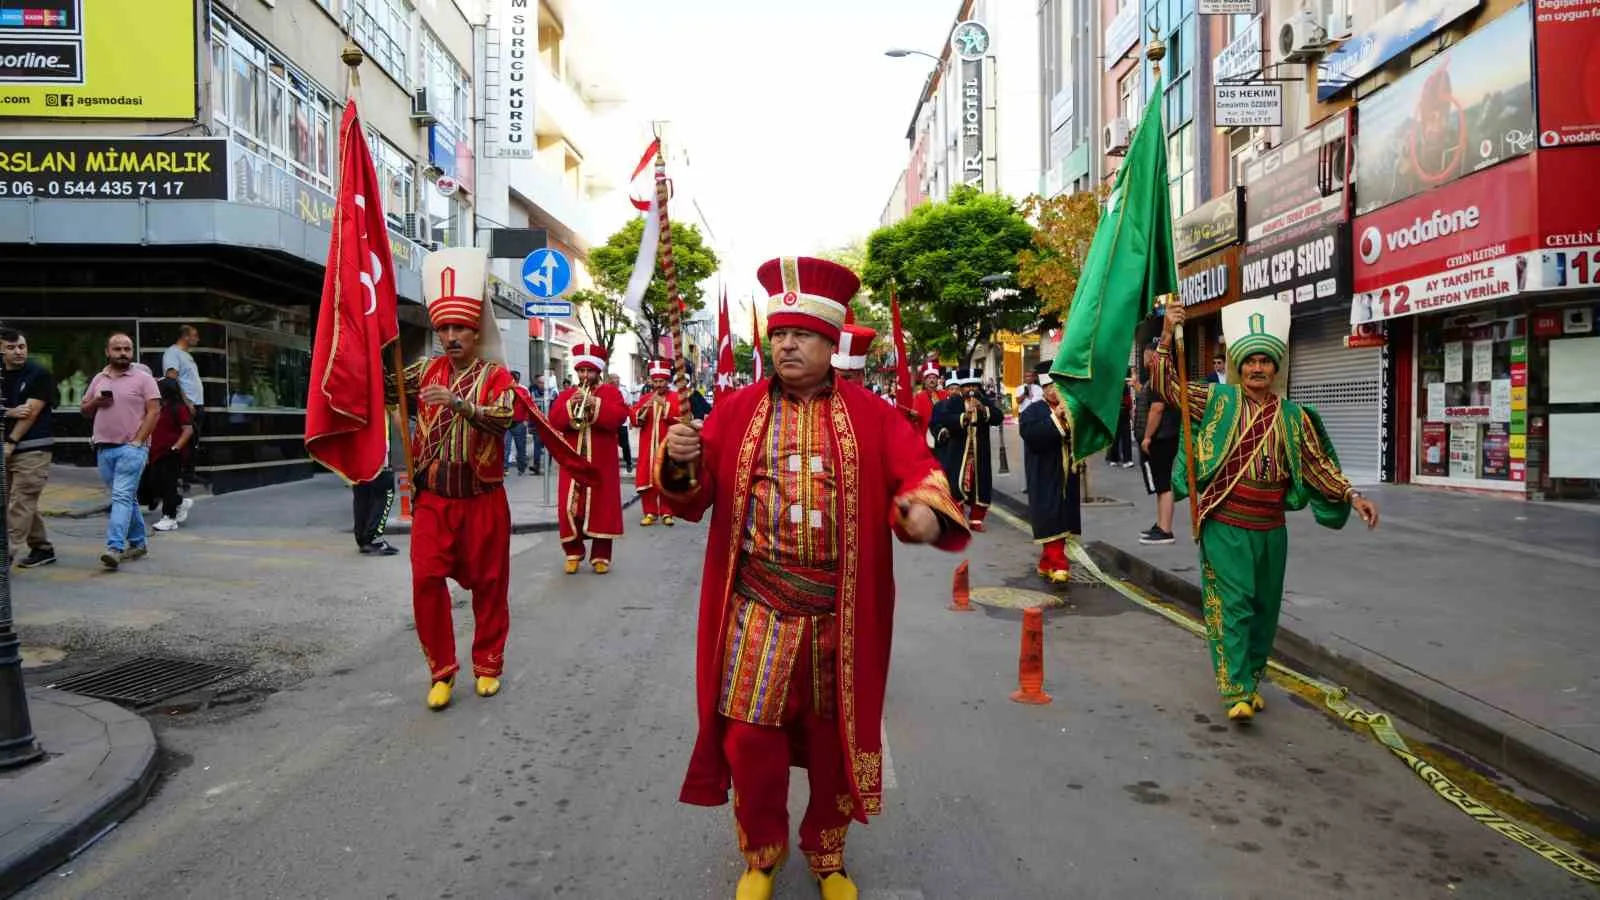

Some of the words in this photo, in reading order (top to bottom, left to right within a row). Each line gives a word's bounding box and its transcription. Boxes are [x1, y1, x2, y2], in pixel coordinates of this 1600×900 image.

[1537, 14, 1553, 22] en
[1554, 10, 1590, 22] uygun
[509, 88, 524, 143] KURSU
[966, 78, 979, 136] HOTEL
[86, 148, 211, 173] MİMARLIK
[12, 181, 34, 195] 06
[48, 181, 60, 195] 0
[64, 181, 96, 195] 544
[100, 181, 133, 195] 435
[138, 181, 157, 195] 71
[163, 181, 184, 195] 17
[1386, 205, 1480, 251] vodafone
[1546, 231, 1593, 246] CEYLİN
[1243, 258, 1270, 294] AYAZ
[1271, 249, 1295, 284] CEP
[1297, 235, 1335, 277] SHOP
[1426, 280, 1438, 292] AY
[1442, 267, 1494, 288] TAKSİTLE
[1180, 264, 1227, 306] ARGELLO
[1379, 284, 1410, 317] 12
[1414, 292, 1461, 310] TELEFON
[1464, 281, 1510, 300] VERİLİR
